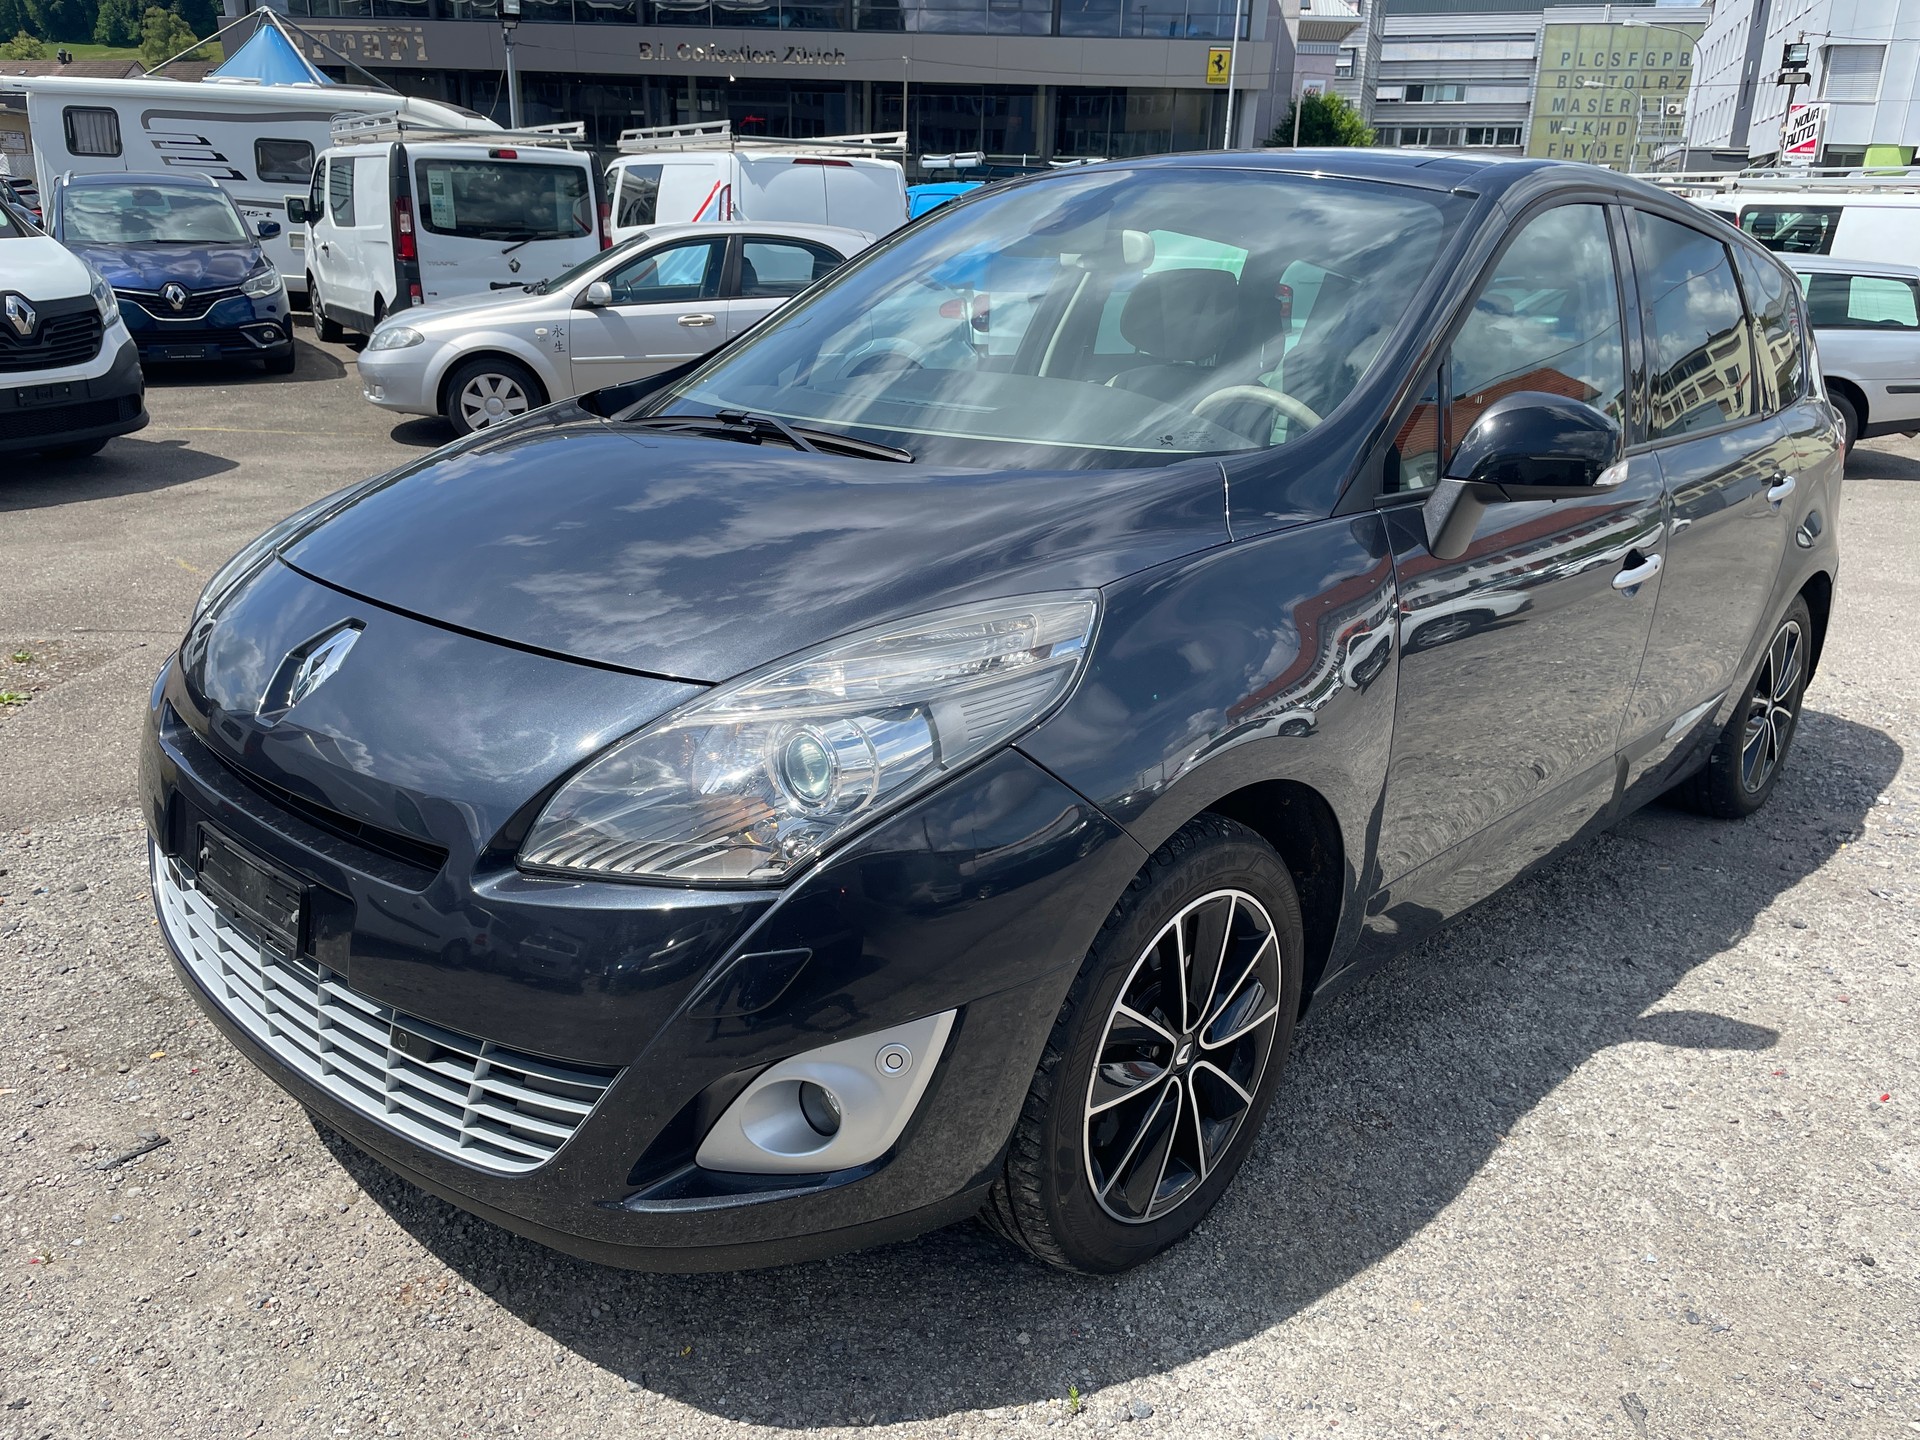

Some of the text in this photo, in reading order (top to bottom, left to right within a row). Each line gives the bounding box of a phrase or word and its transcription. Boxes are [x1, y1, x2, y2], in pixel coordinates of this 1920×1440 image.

[676, 43, 777, 64] Collection
[782, 45, 846, 65] Zürich
[1793, 107, 1820, 131] NOVA
[1785, 123, 1816, 151] AUTO
[552, 324, 566, 353] 永生
